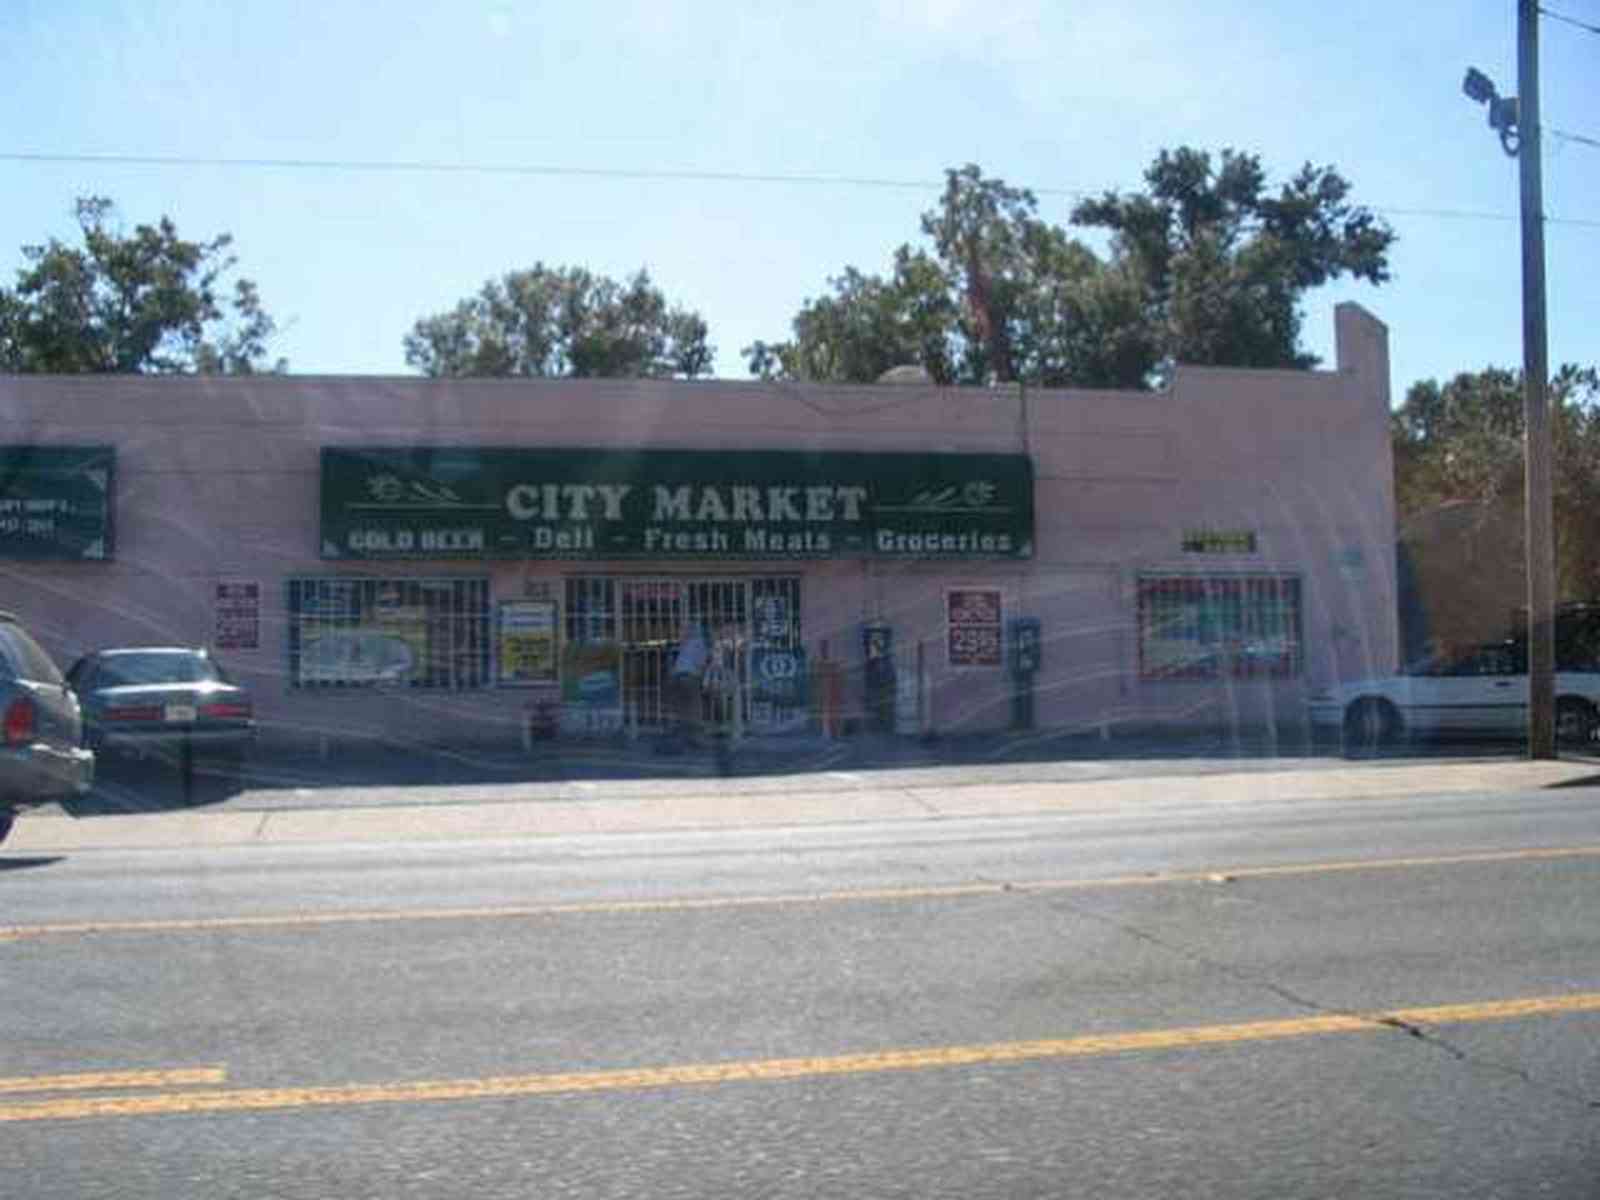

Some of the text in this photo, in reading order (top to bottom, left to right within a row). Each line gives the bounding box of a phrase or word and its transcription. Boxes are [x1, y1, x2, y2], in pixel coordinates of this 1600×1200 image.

[506, 483, 868, 522] CITY MARKET
[644, 528, 729, 551] Fresh
[744, 528, 831, 551] Meats
[877, 529, 1012, 552] Groceries
